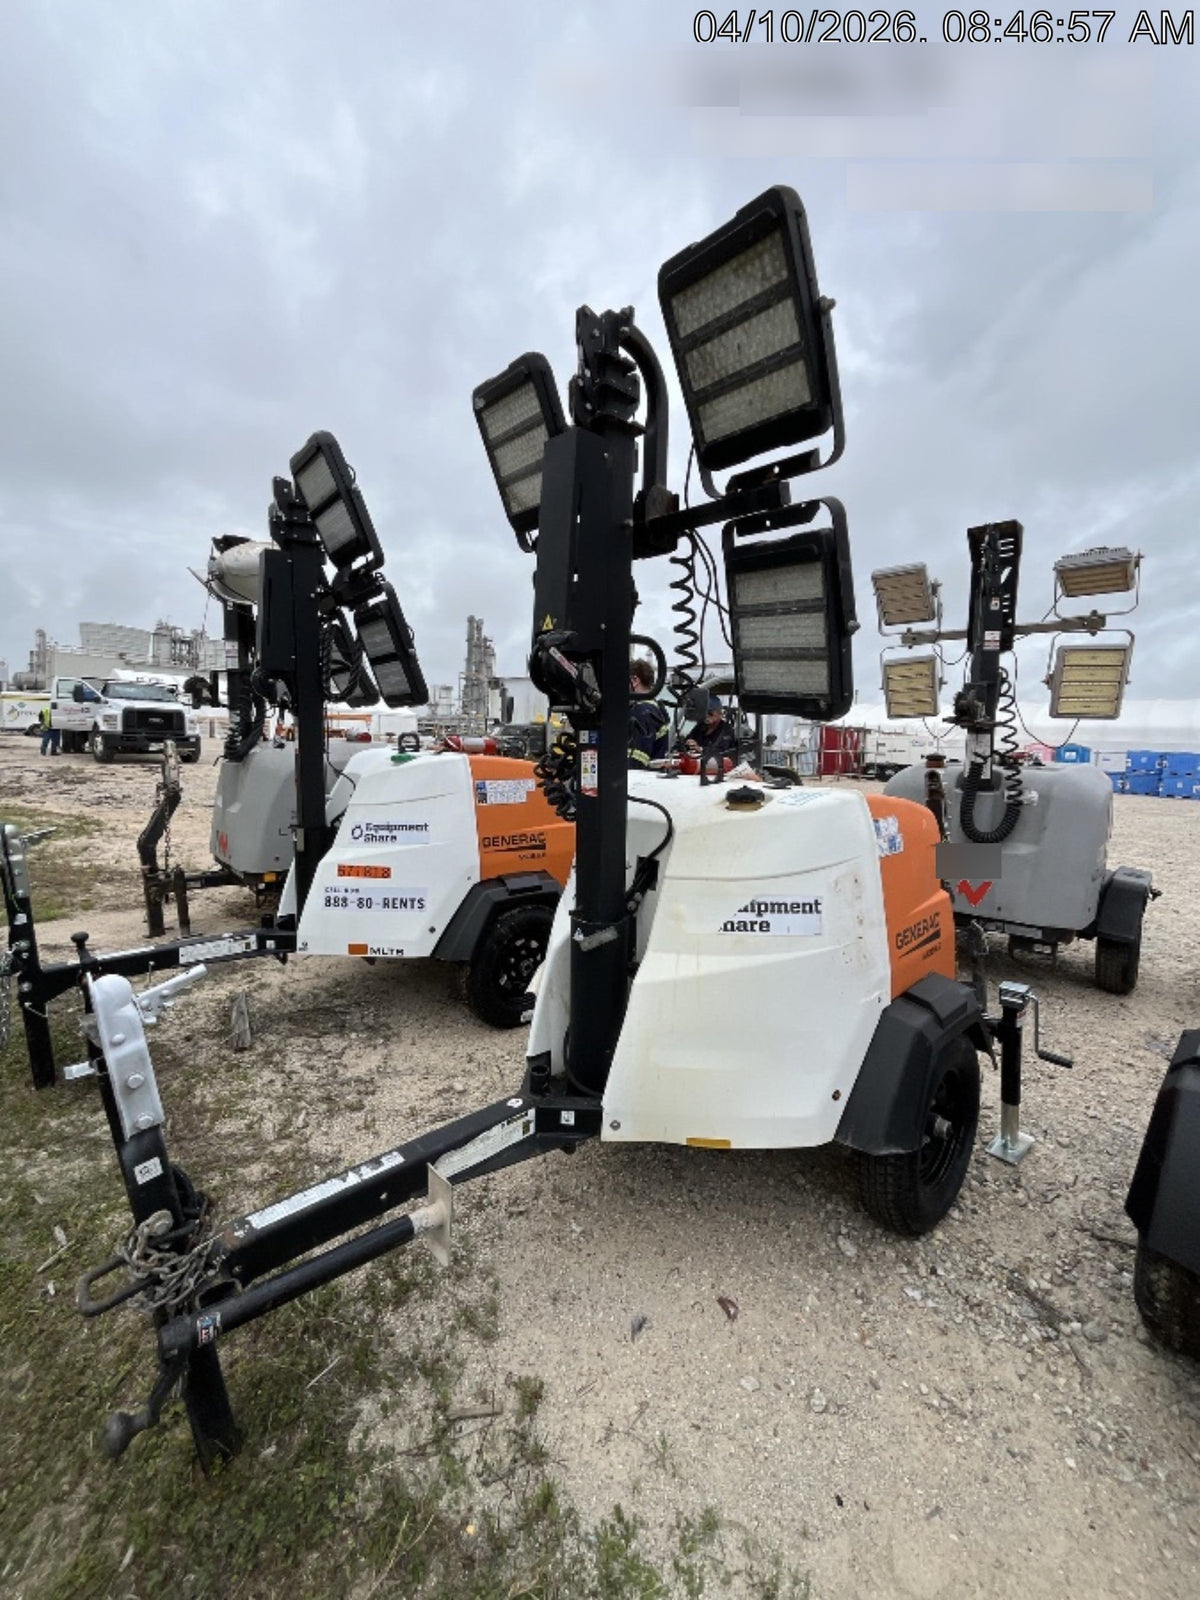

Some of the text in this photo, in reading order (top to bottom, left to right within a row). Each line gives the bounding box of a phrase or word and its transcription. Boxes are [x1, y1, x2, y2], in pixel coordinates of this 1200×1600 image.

[365, 822, 429, 834] Equipment
[364, 833, 397, 842] Share
[482, 832, 546, 848] GENERAC
[735, 899, 822, 918] uipment
[718, 920, 771, 933] hare
[895, 911, 940, 950] GENERAC
